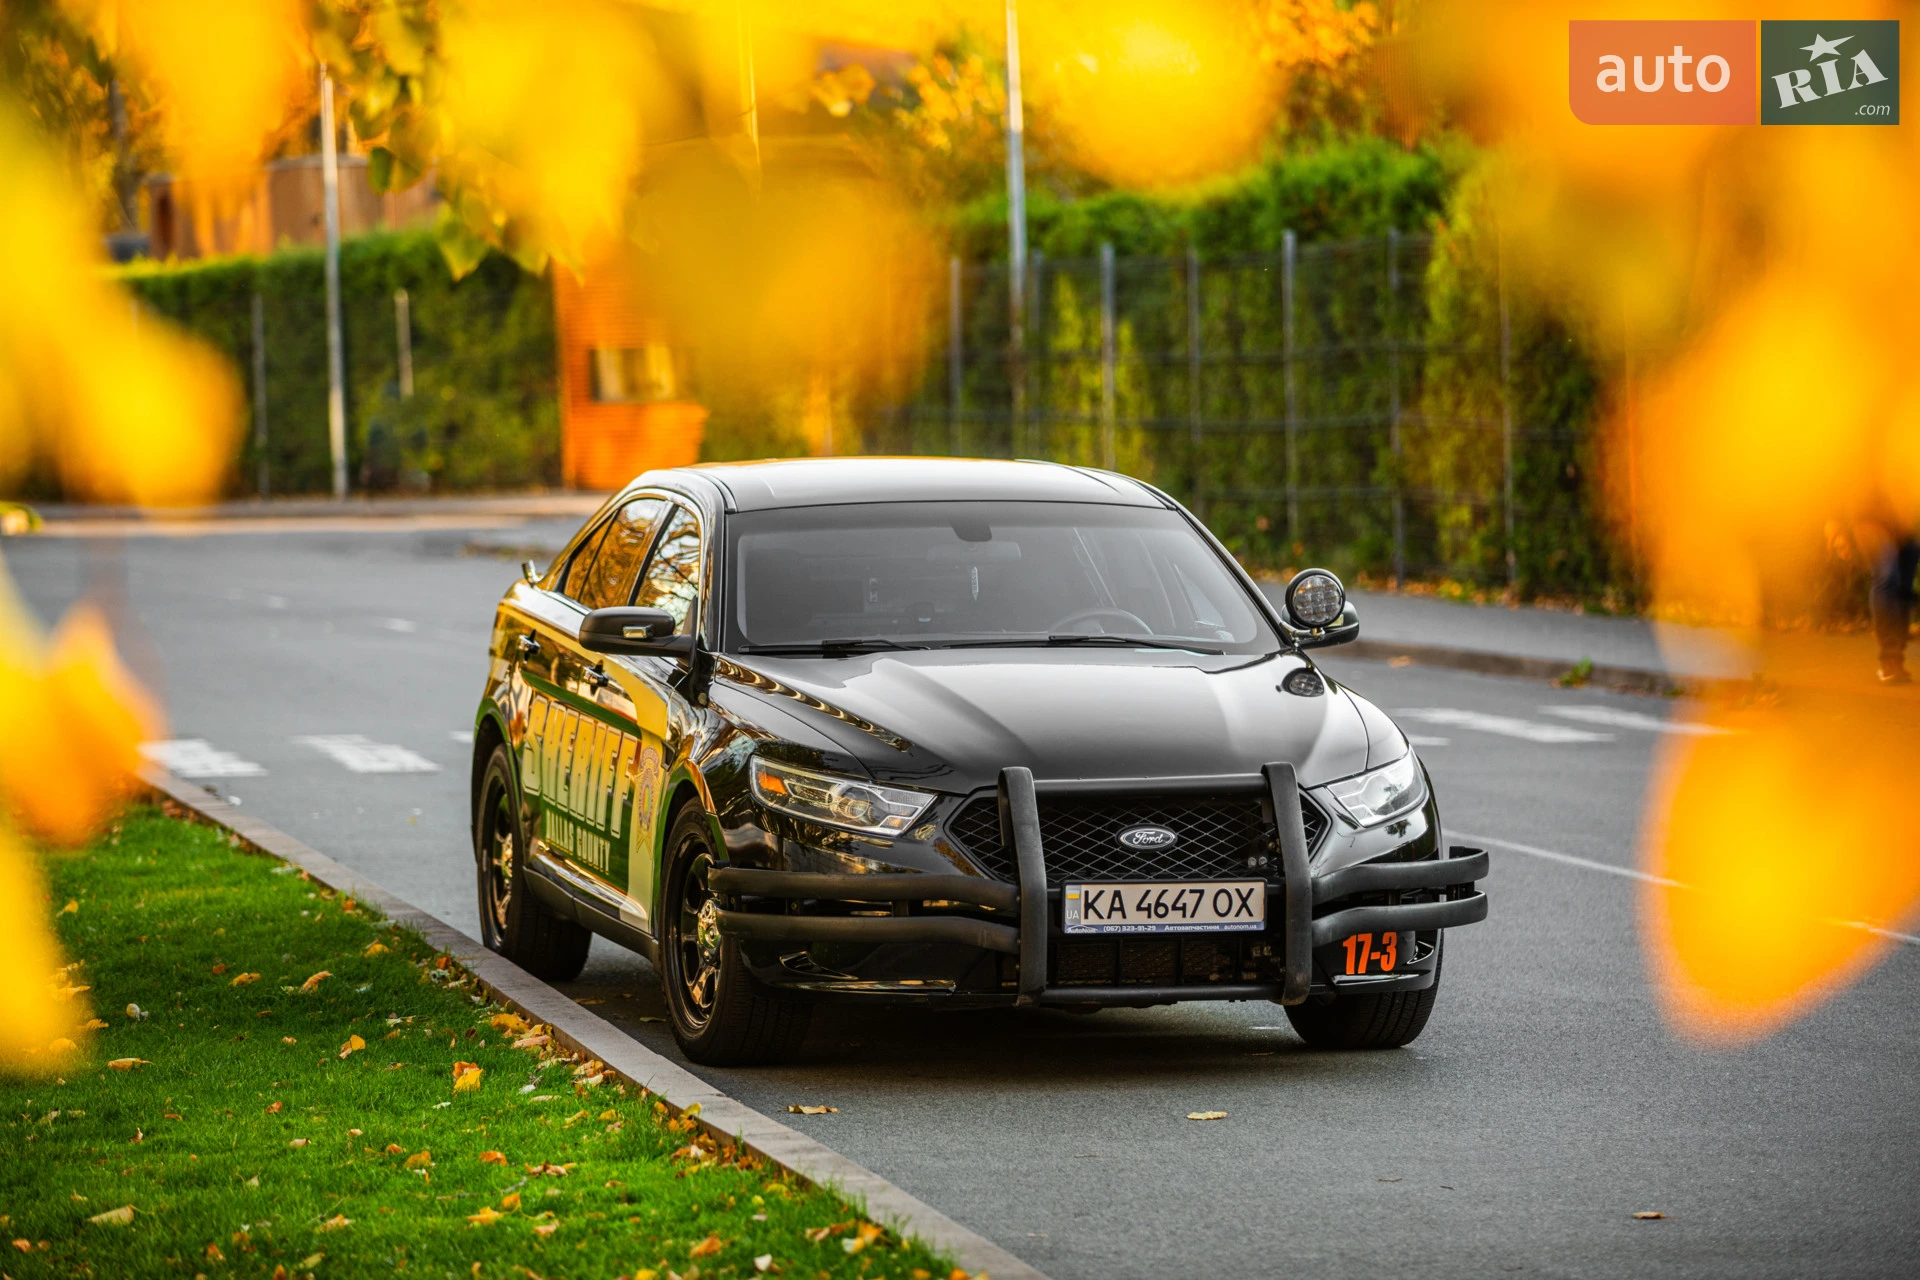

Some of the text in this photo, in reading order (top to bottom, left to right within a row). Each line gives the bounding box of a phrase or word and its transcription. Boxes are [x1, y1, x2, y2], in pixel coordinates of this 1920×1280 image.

[521, 694, 638, 840] SHERIFF
[545, 808, 611, 875] DALLAS COUNTY
[1132, 831, 1164, 845] Ford
[1066, 909, 1080, 920] UA
[1083, 887, 1255, 920] KA 4647 OX
[1342, 931, 1398, 975] 17-3
